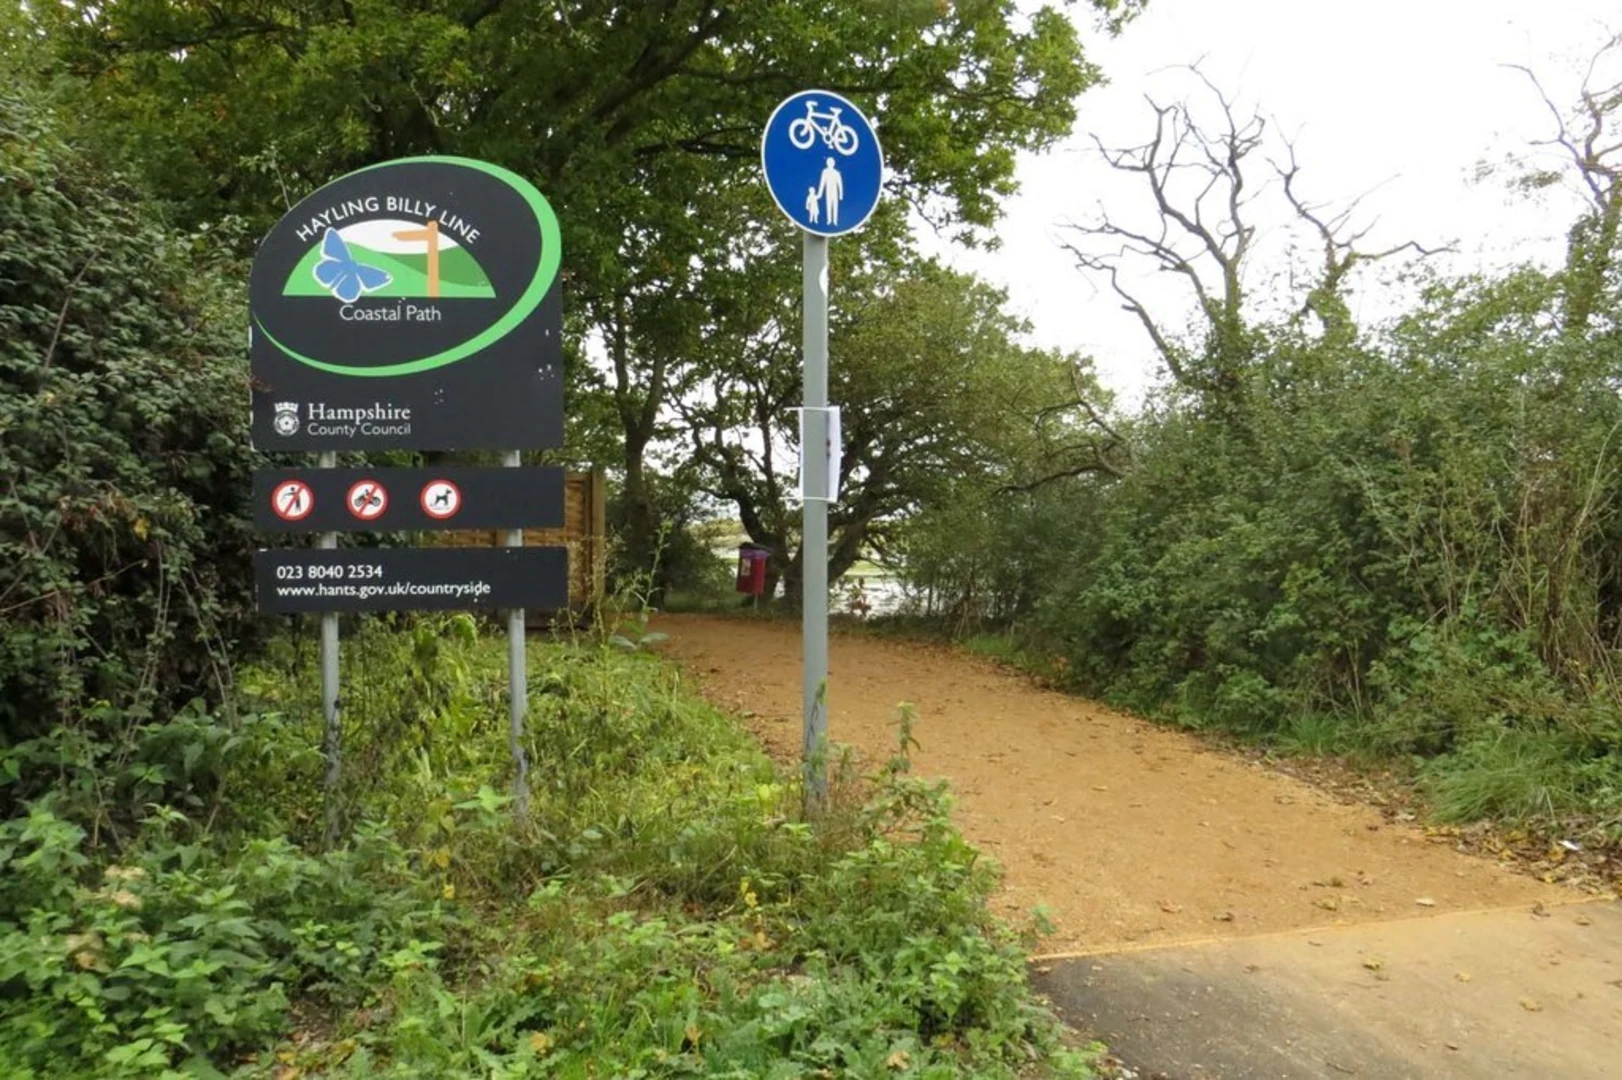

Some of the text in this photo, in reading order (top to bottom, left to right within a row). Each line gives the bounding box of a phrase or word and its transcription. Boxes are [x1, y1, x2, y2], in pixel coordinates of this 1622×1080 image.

[296, 196, 481, 245] HAYLING BILLY LINE
[339, 305, 442, 321] Coastal Path
[308, 402, 411, 425] Hampshire
[307, 423, 411, 438] County Council
[276, 564, 383, 579] 023 8040 2534
[276, 581, 491, 599] www.hants.gov.uk/countryside
